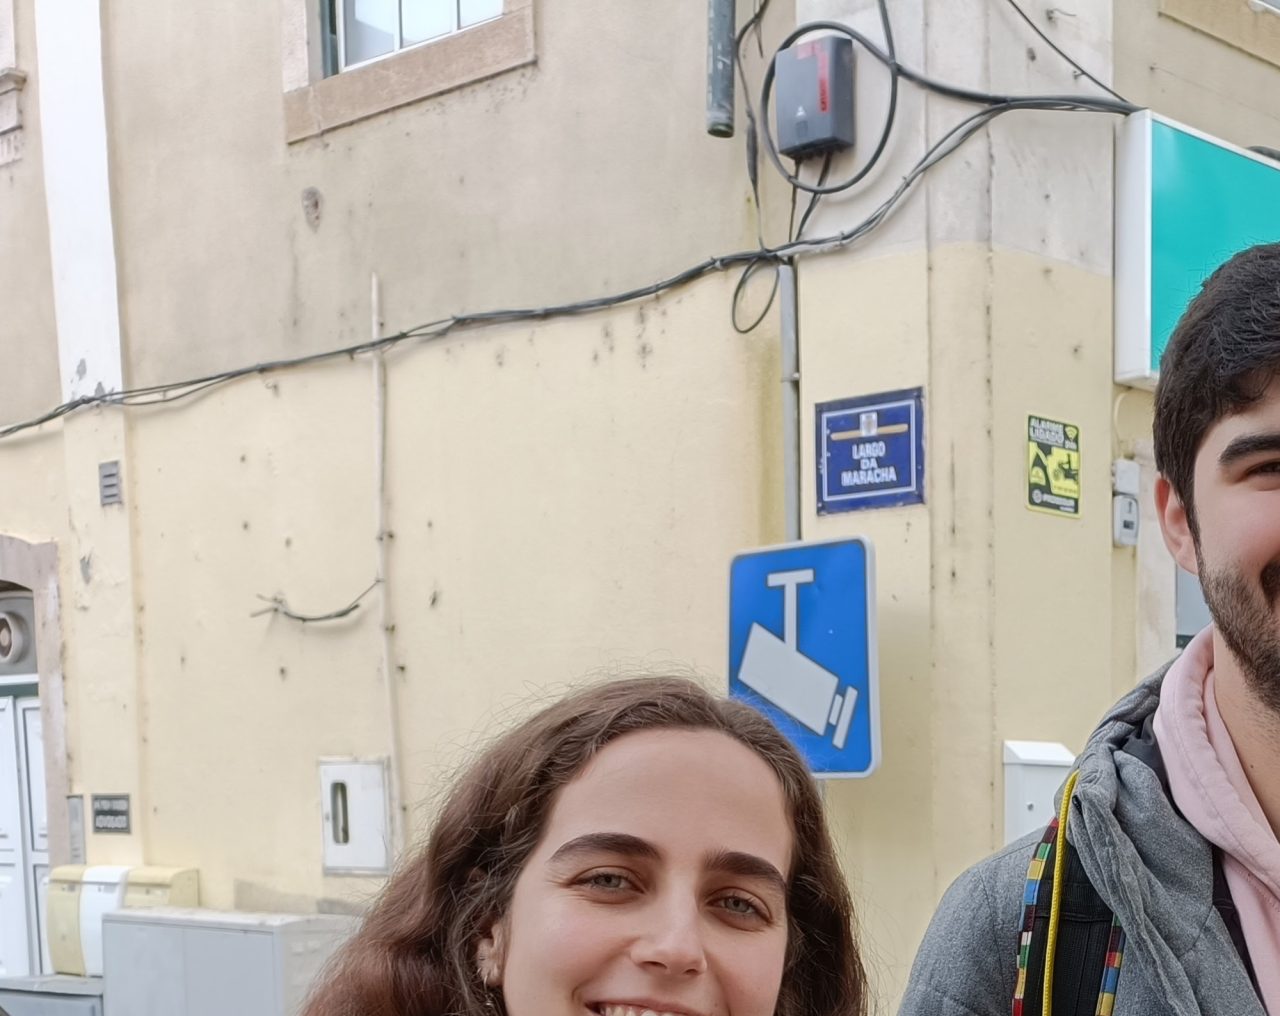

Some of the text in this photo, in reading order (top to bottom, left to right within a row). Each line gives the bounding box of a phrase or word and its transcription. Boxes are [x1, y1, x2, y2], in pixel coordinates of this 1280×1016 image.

[852, 441, 886, 460] LARGO
[860, 457, 878, 470] DA
[841, 466, 897, 487] MARACHA
